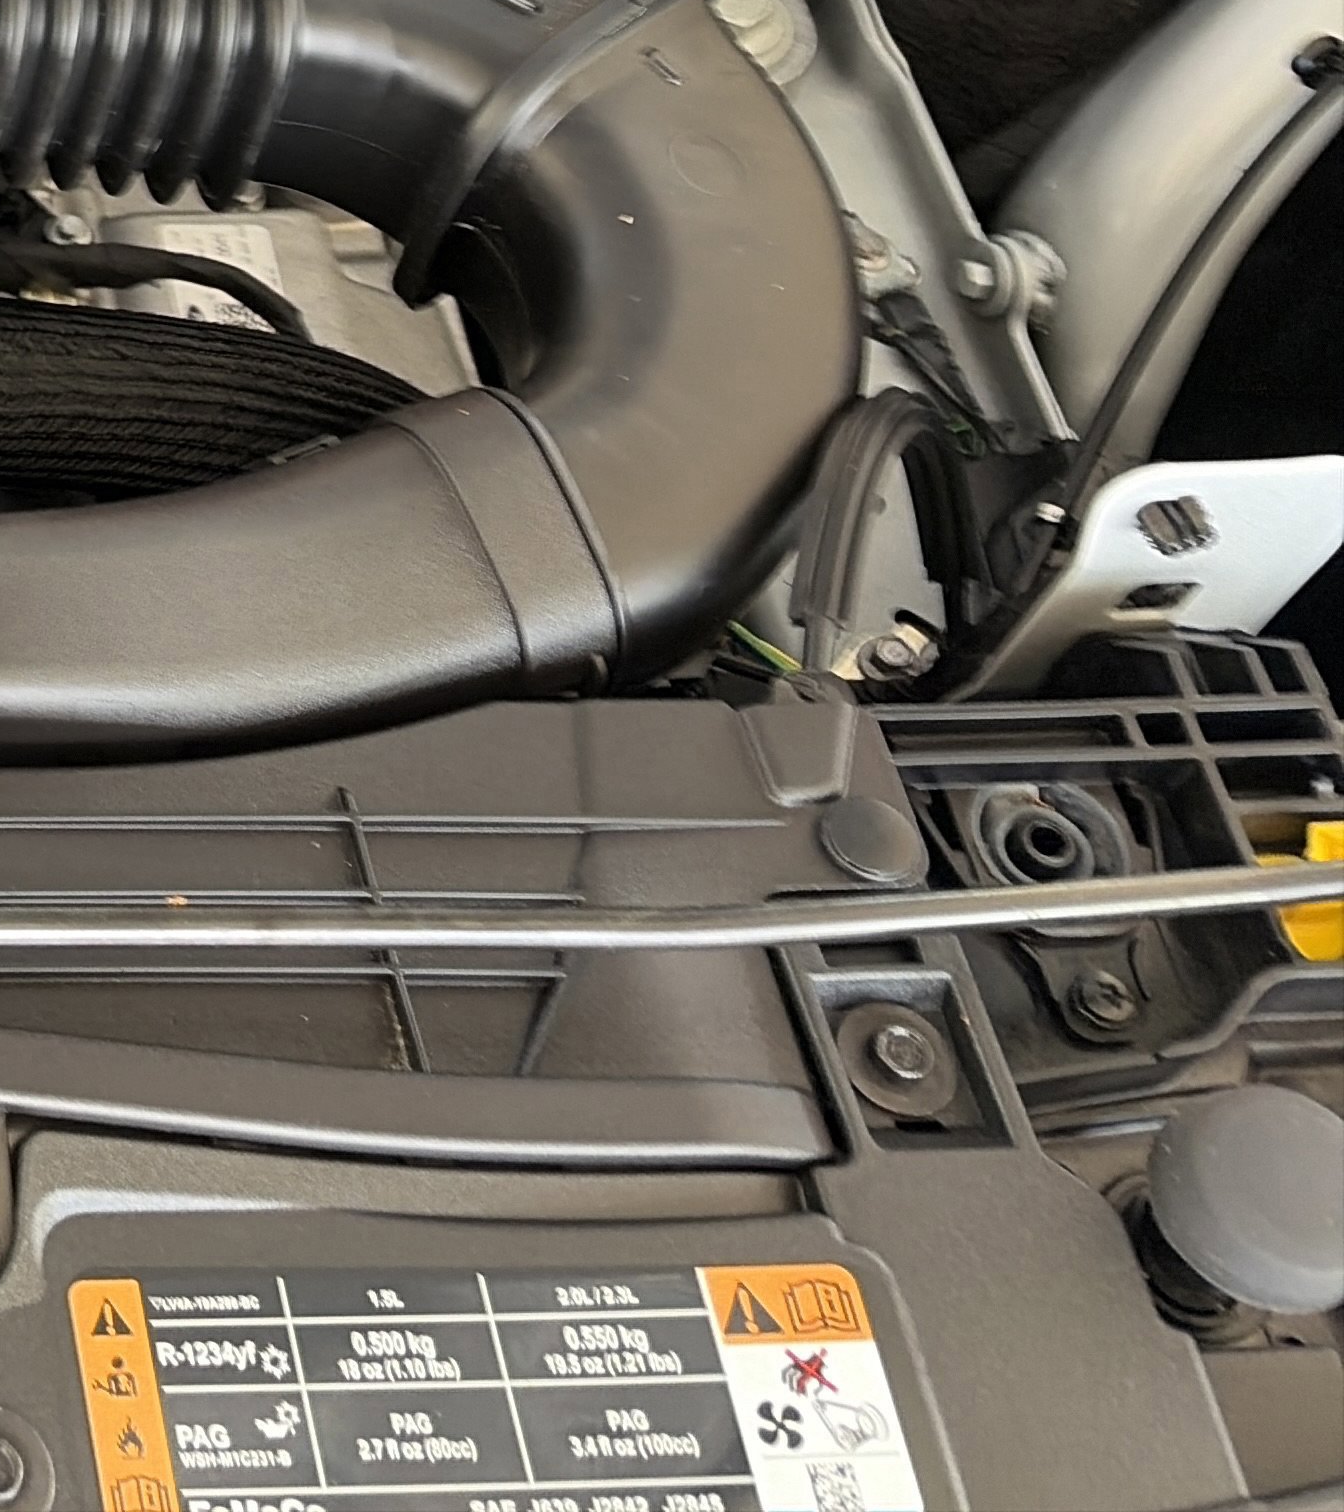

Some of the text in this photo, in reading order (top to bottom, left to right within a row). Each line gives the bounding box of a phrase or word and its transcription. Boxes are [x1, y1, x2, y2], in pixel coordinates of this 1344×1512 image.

[365, 1288, 405, 1309] 1.5L
[350, 1330, 436, 1359] 0.500 kg
[563, 1324, 649, 1354] 0.550 kg
[154, 1340, 257, 1371] R-1234yf
[543, 1350, 682, 1377] 19.5 oz (1.21 lbs)
[337, 1357, 461, 1382] 18 oz (1.10 lbs)
[389, 1412, 434, 1435] PAG
[605, 1409, 650, 1432] PAG
[174, 1423, 231, 1450] PAG
[357, 1437, 383, 1461] 2.7
[401, 1441, 425, 1461] oz
[423, 1436, 478, 1464] (80cc)
[568, 1435, 599, 1459] 3.4
[613, 1437, 637, 1458] oz
[635, 1432, 700, 1460] (100cc)
